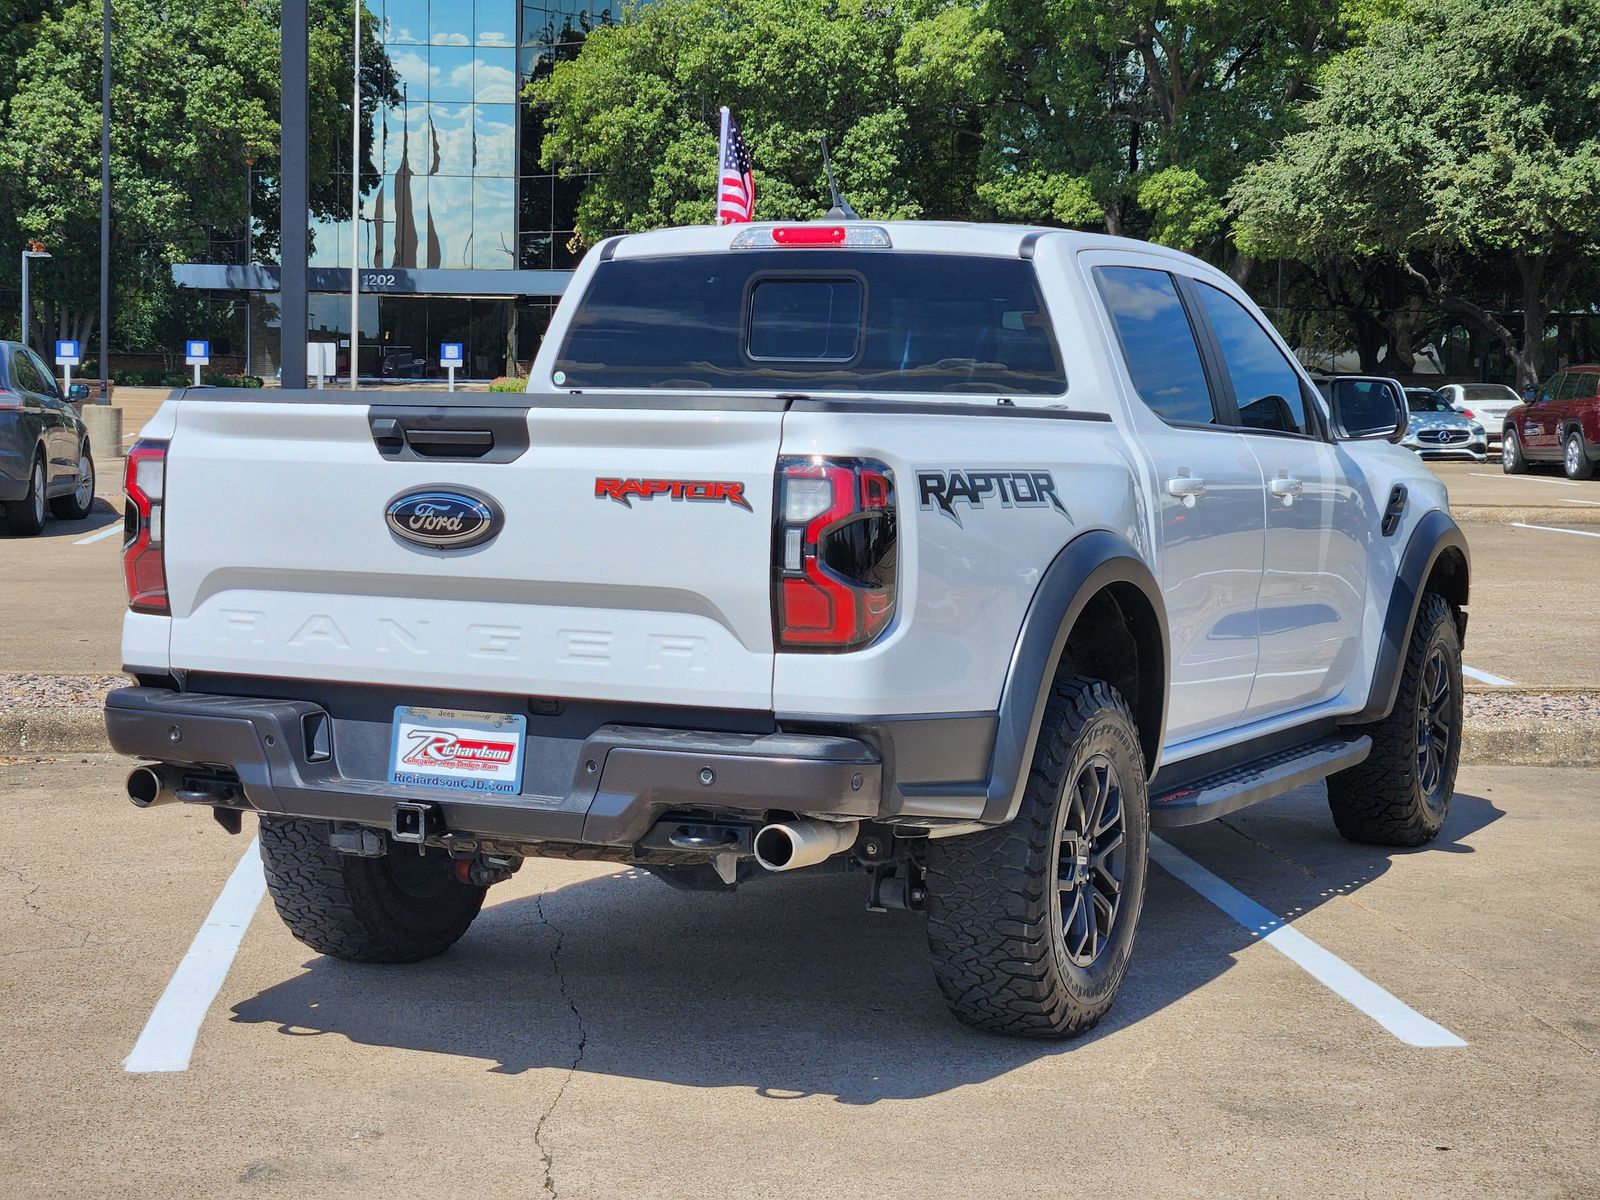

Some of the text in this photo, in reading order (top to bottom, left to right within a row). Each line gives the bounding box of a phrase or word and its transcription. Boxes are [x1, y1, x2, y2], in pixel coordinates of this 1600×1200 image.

[362, 274, 396, 286] 1202
[595, 477, 753, 513] RAPTOR
[915, 469, 1075, 530] RAPTOR
[409, 503, 464, 531] Ford
[216, 608, 706, 672] RANGER
[438, 710, 456, 718] Jeep
[402, 729, 511, 763] Richardson
[481, 763, 499, 771] Ram
